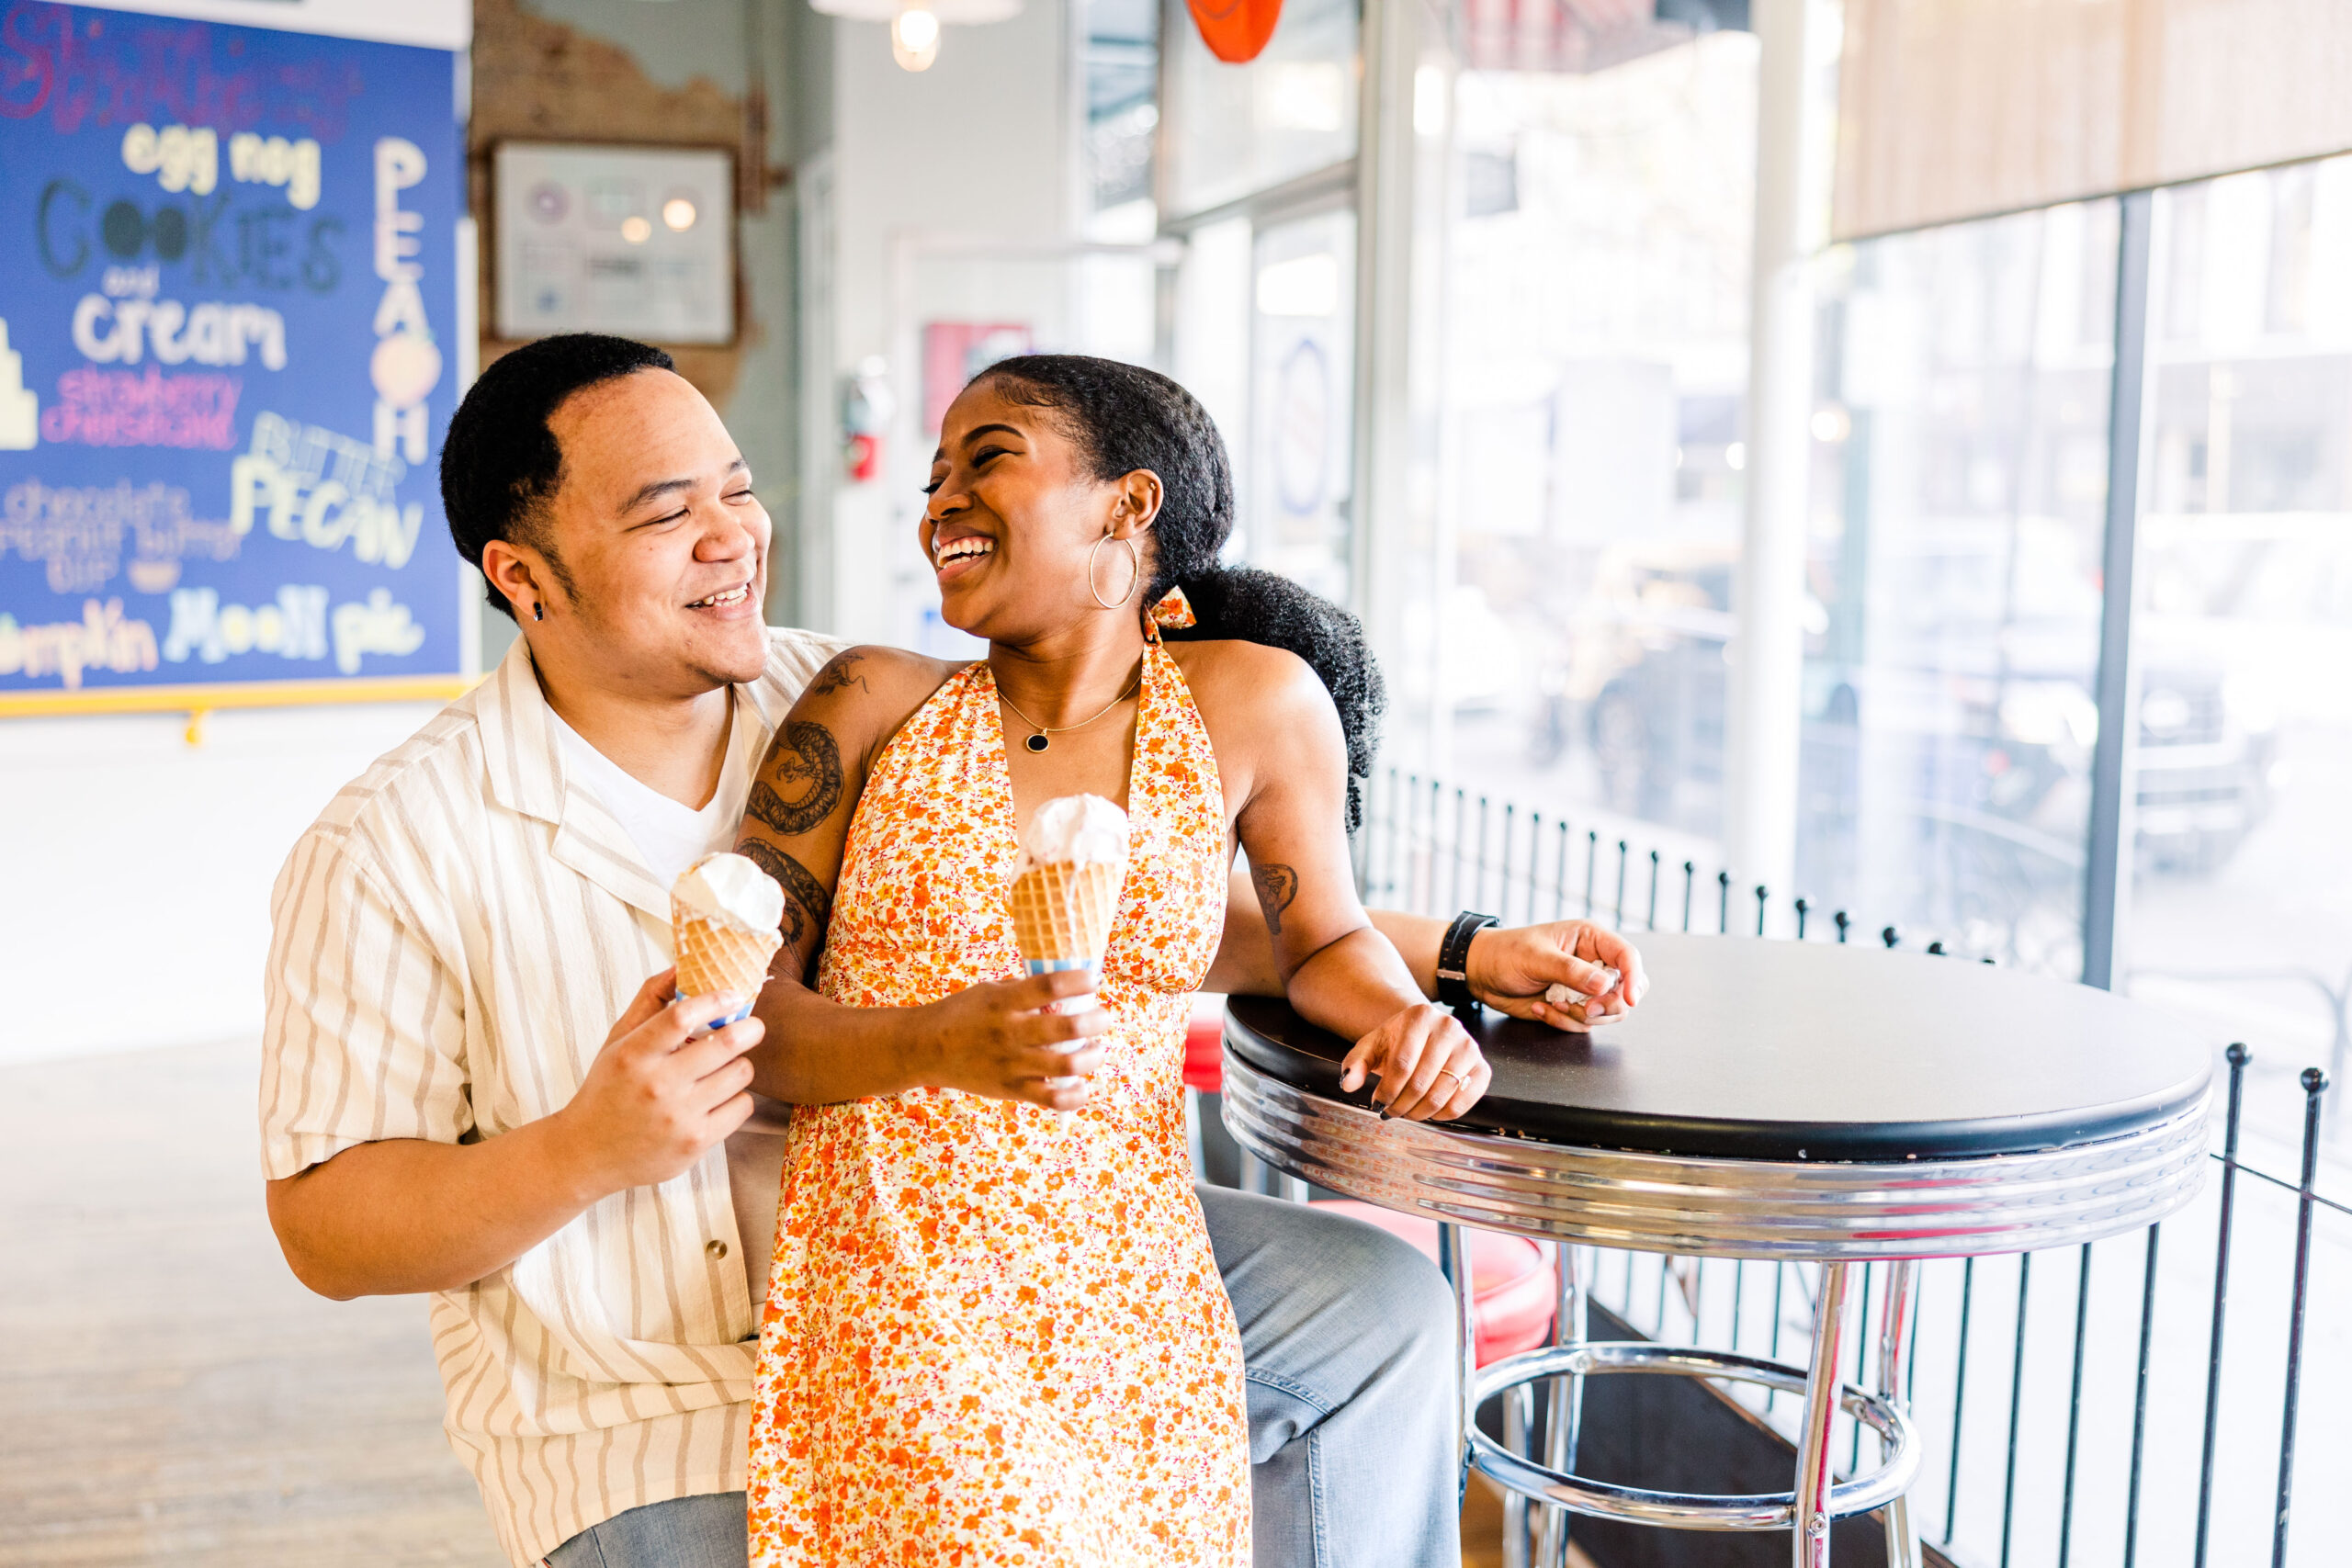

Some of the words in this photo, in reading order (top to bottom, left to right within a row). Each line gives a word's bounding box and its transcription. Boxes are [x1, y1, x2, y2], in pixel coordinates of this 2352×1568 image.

[121, 123, 220, 196] egg
[229, 133, 322, 210] nog
[373, 137, 441, 465] PEAH
[230, 456, 424, 570] PECAN
[0, 597, 159, 690] mpkin
[333, 587, 426, 675] pie
